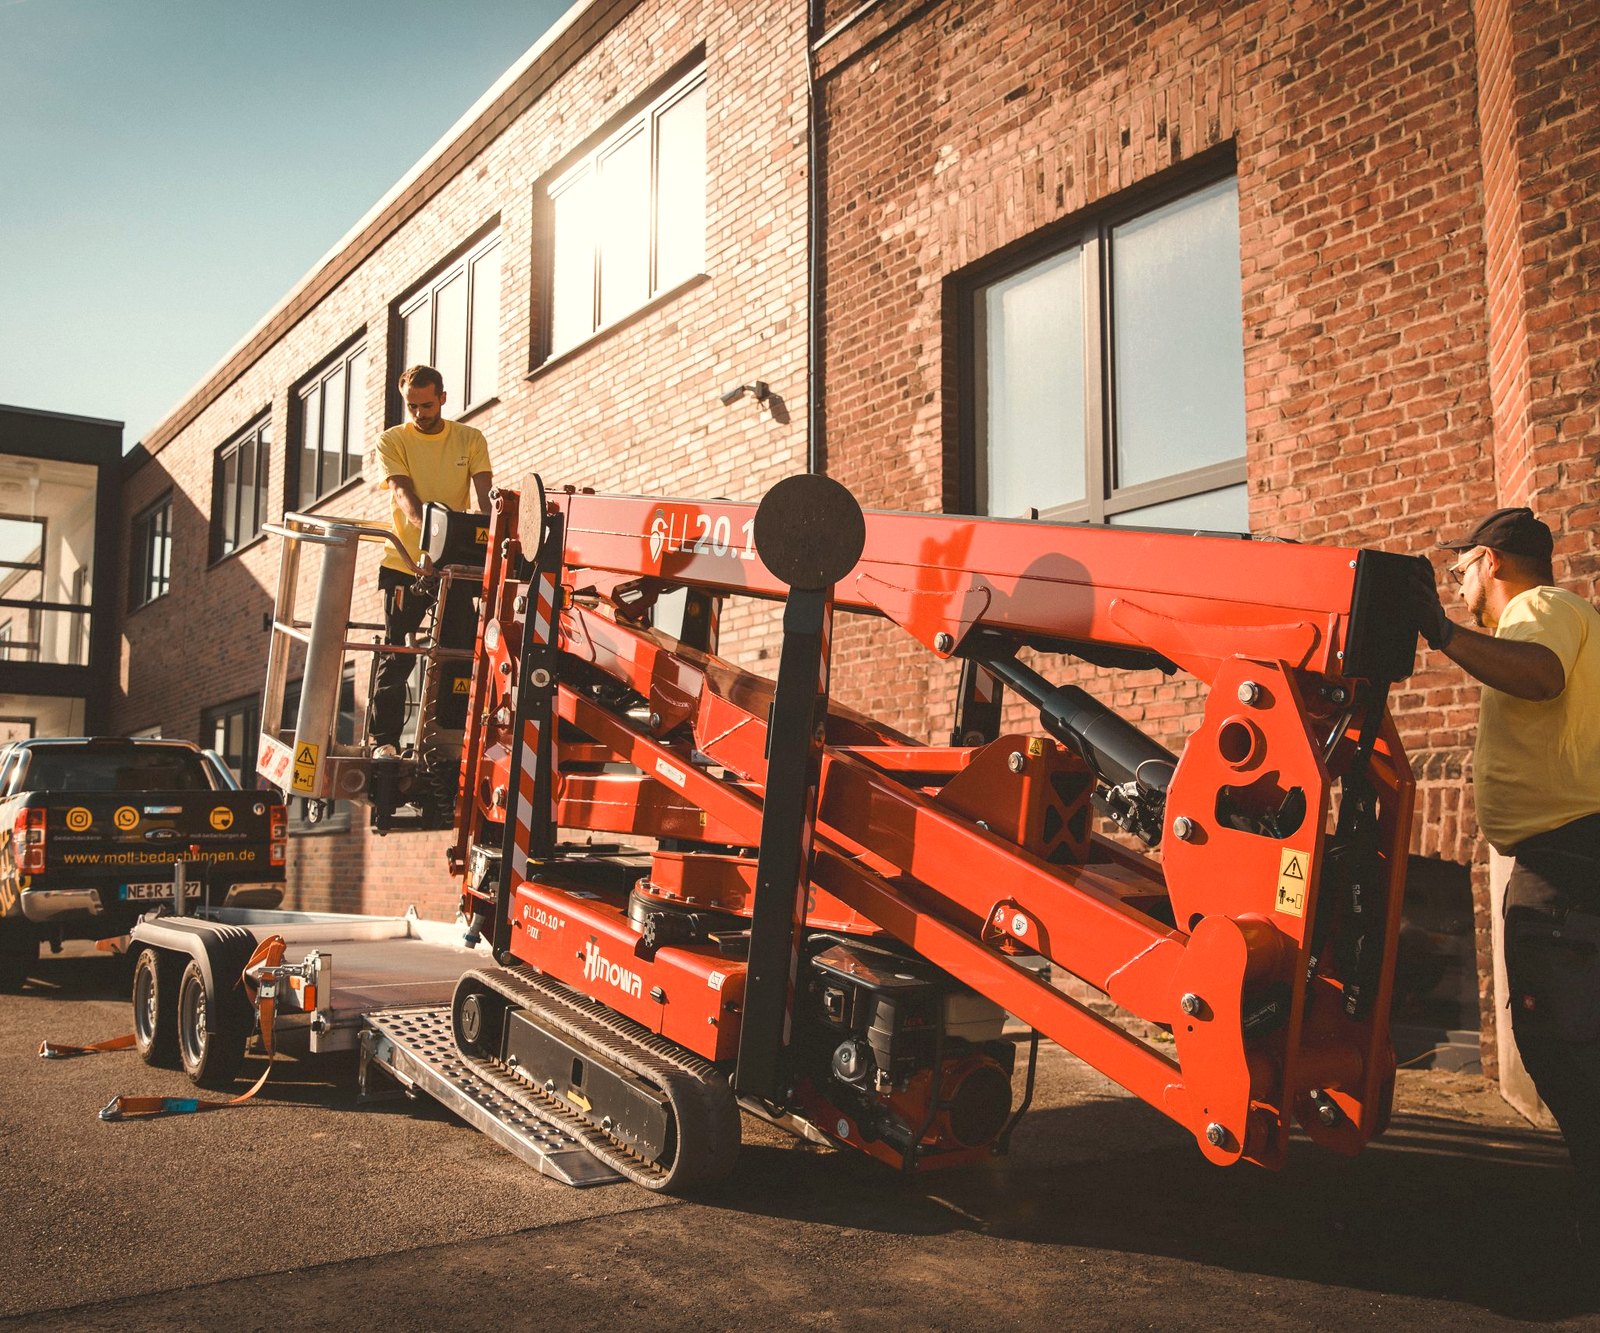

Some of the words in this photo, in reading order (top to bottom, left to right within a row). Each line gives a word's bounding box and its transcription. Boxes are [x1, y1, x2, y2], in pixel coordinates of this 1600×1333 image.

[667, 511, 755, 560] LL20.1
[63, 849, 256, 864] www.moll-bedachungen.de
[127, 885, 145, 898] NE
[154, 884, 163, 897] R
[165, 882, 199, 897] 127
